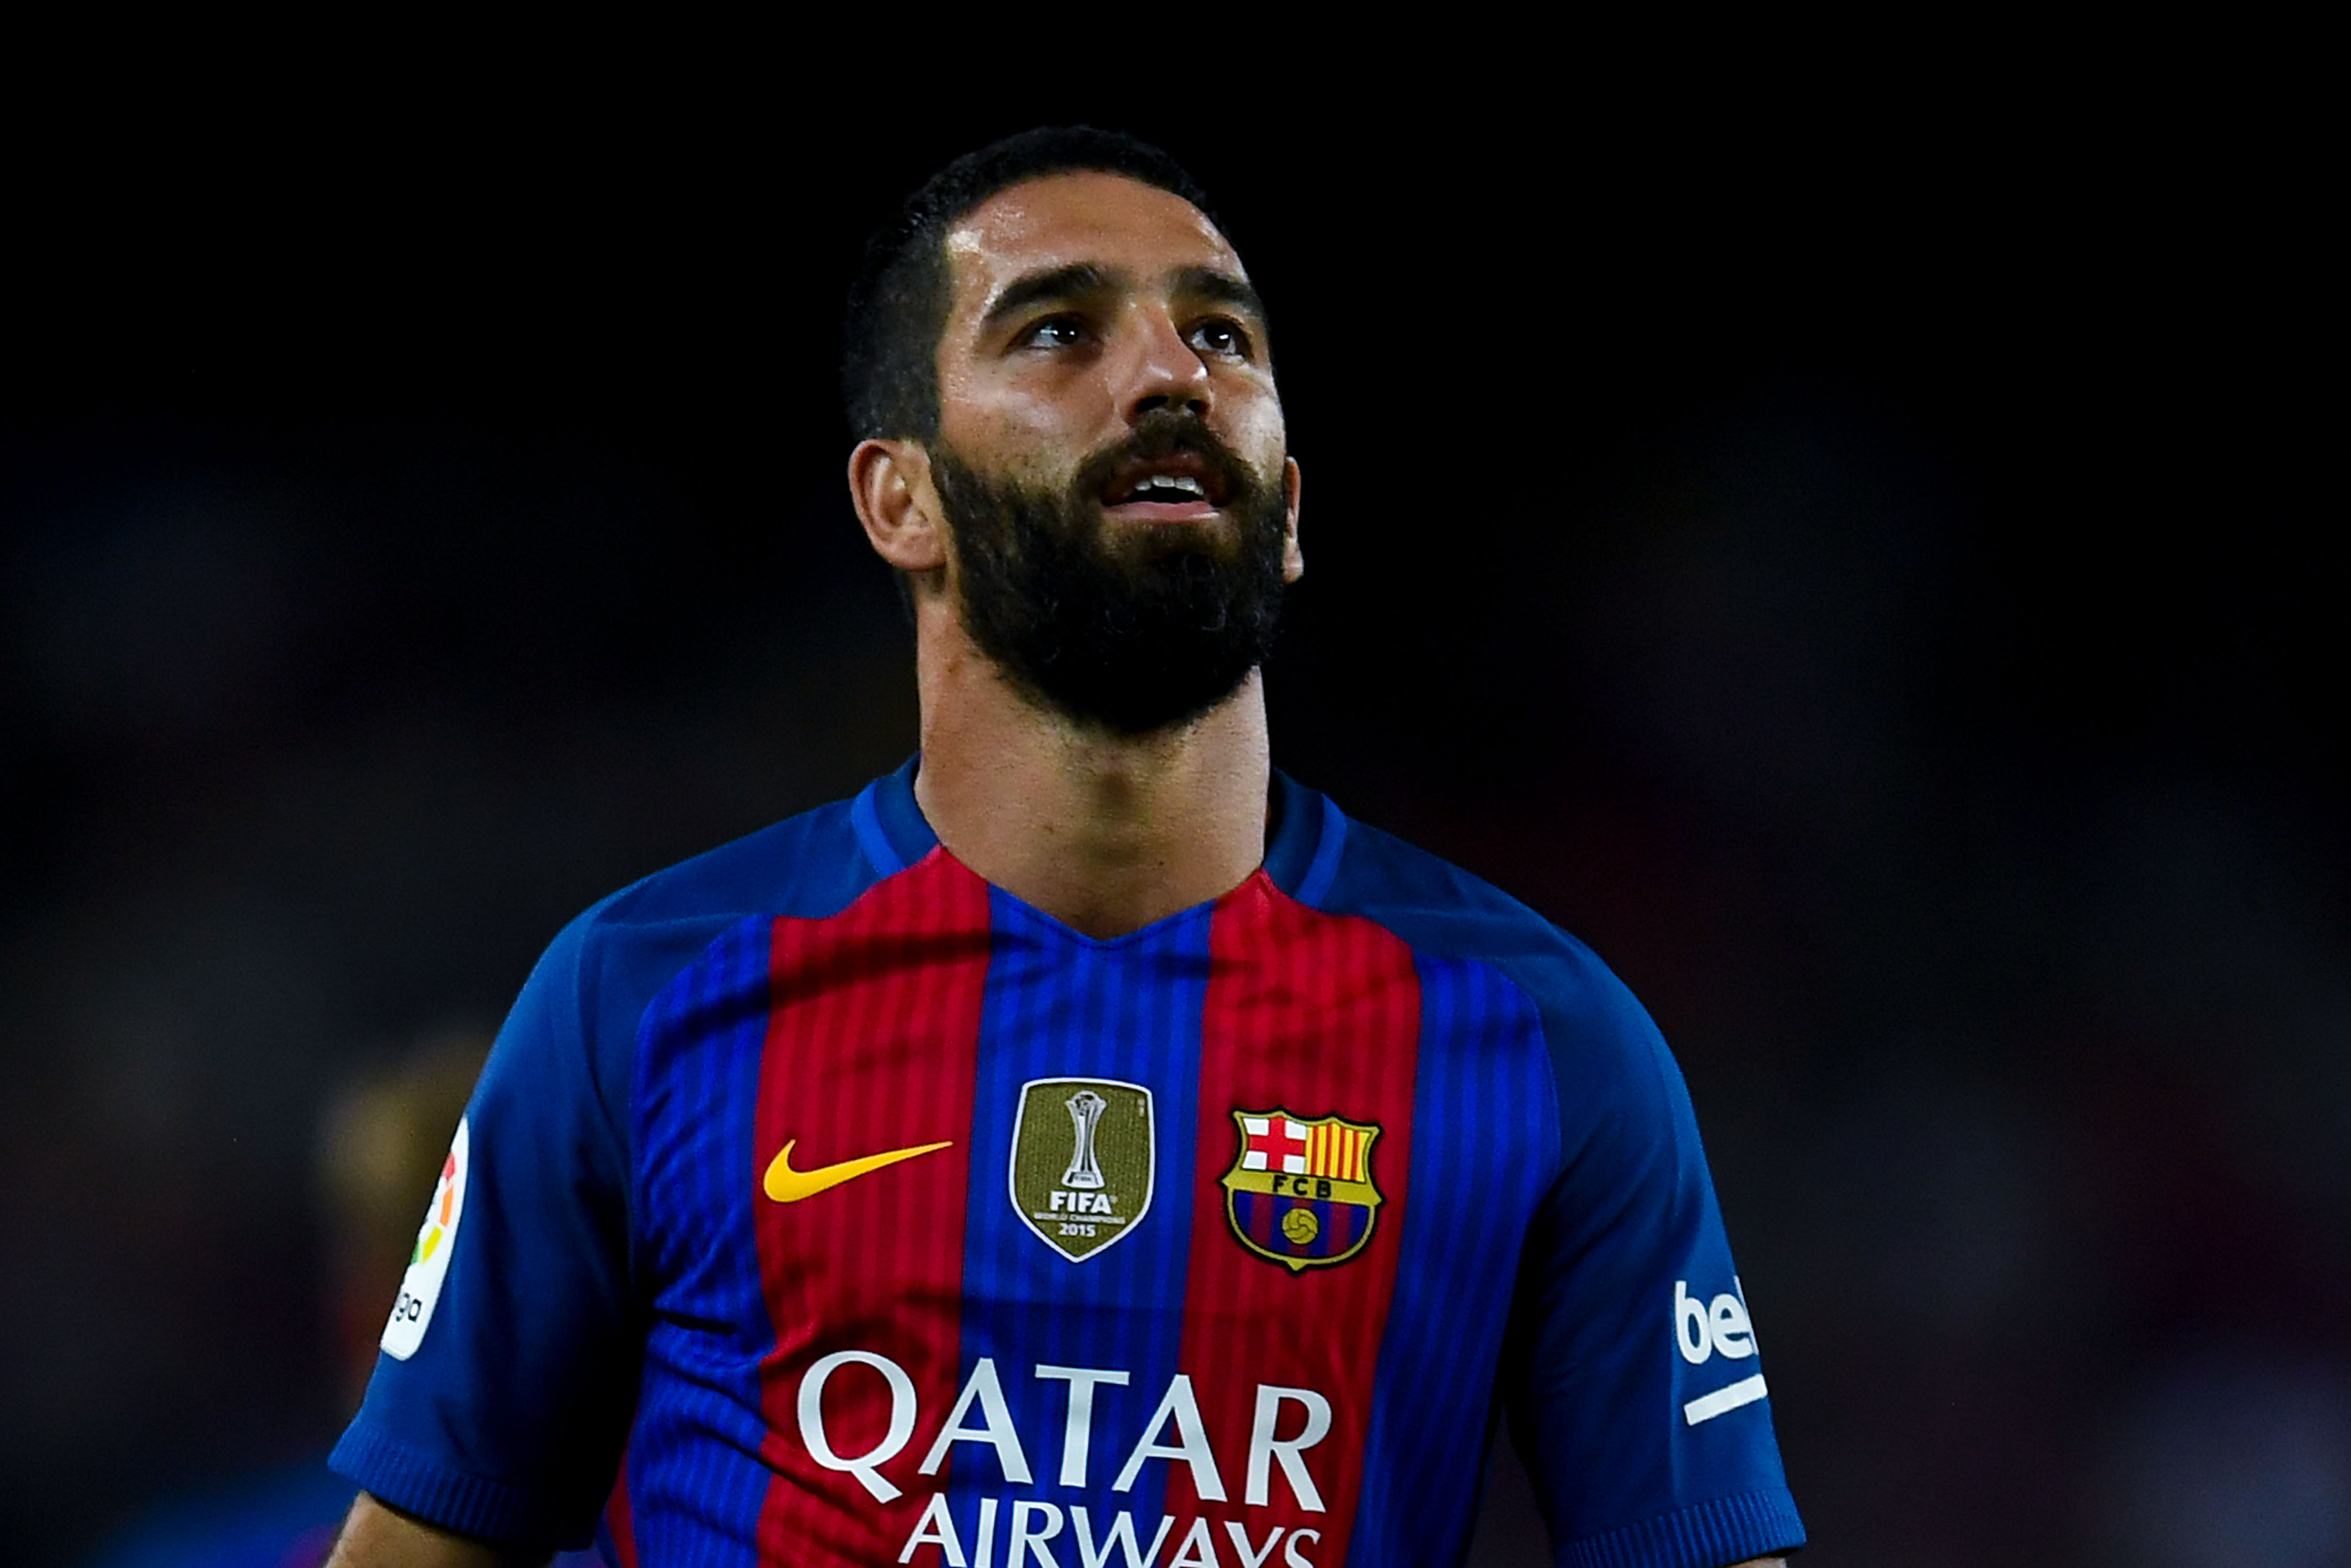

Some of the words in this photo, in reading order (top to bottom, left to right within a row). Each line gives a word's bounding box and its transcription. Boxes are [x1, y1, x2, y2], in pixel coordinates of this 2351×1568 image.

[1050, 1191, 1112, 1215] FIFA
[1058, 1223, 1097, 1238] 2015
[797, 1350, 1332, 1513] QATAR
